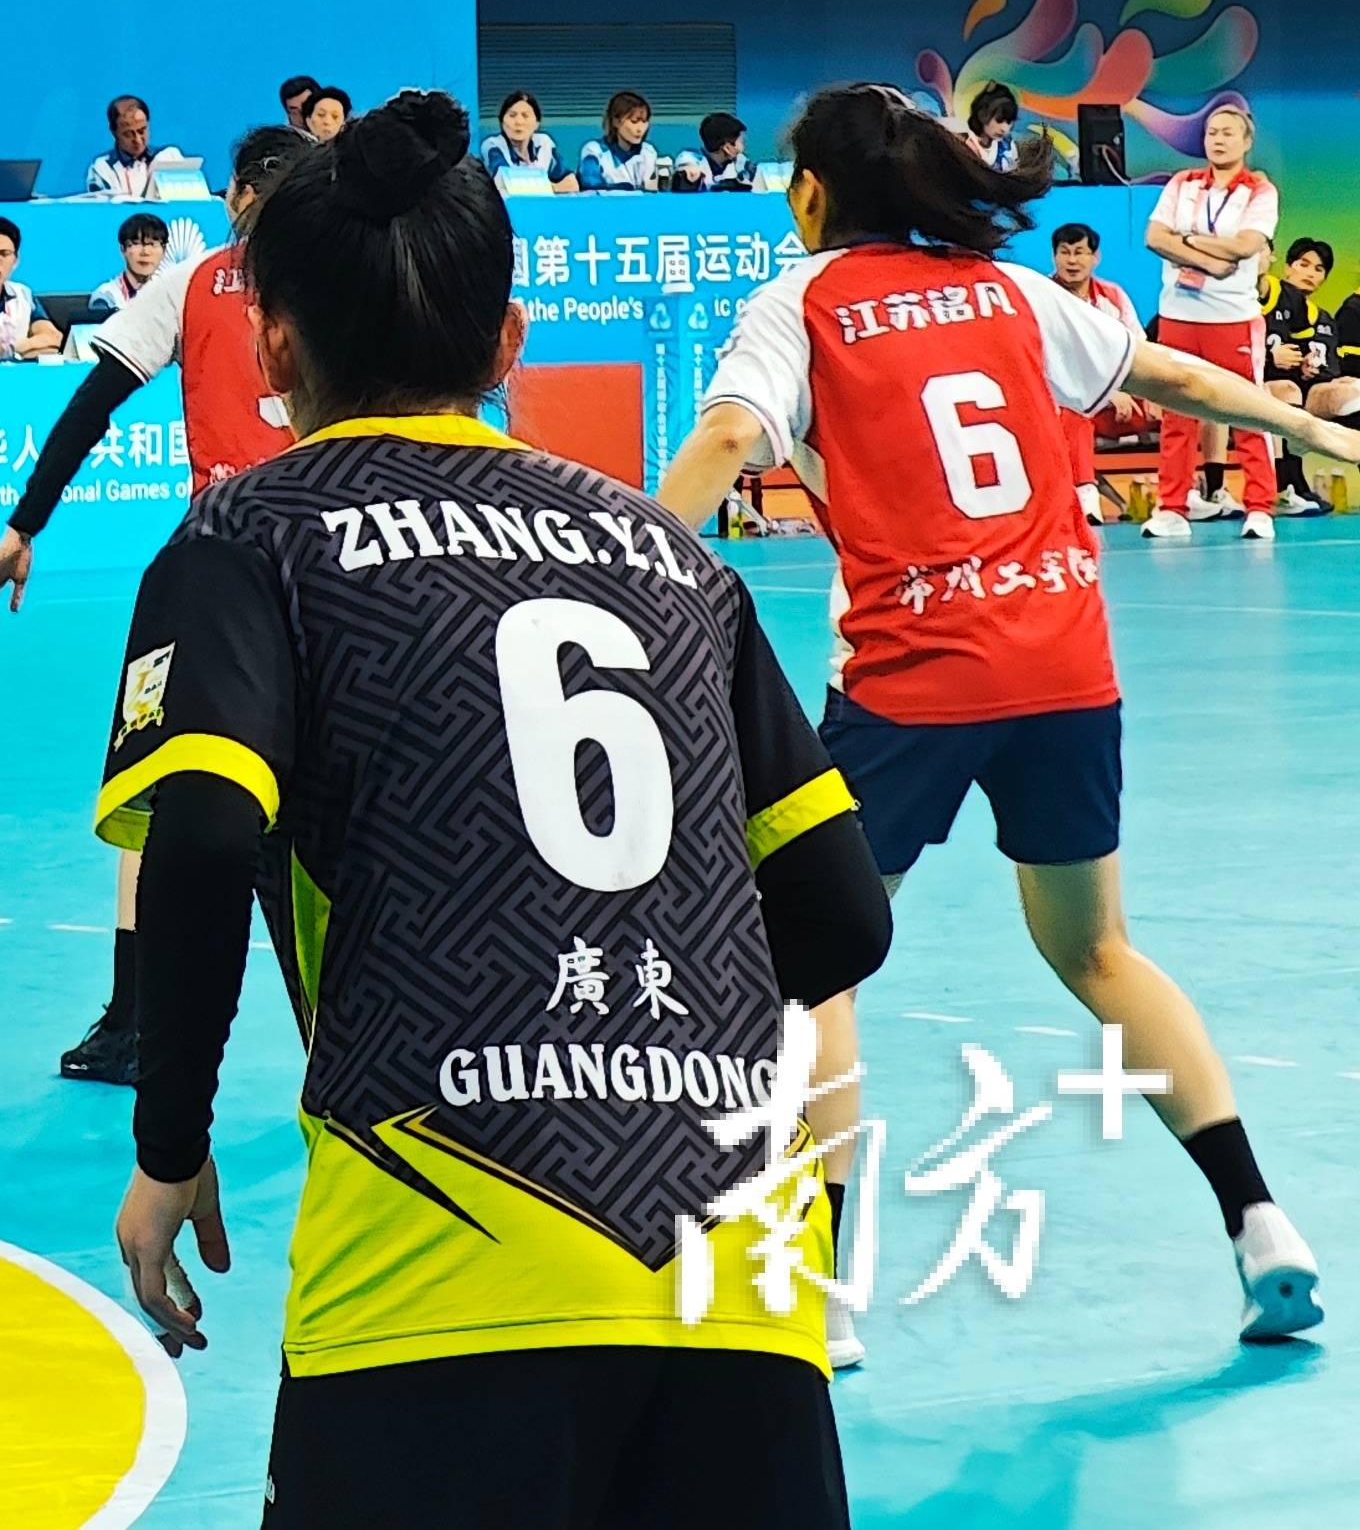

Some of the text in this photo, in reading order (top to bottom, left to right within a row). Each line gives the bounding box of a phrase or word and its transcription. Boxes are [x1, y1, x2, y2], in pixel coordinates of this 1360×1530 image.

[564, 295, 644, 325] People's
[920, 370, 1033, 520] 6
[106, 478, 170, 502] Games
[496, 598, 674, 893] 6
[545, 936, 689, 1021] 廣東
[439, 1043, 780, 1110] GUANGDONG
